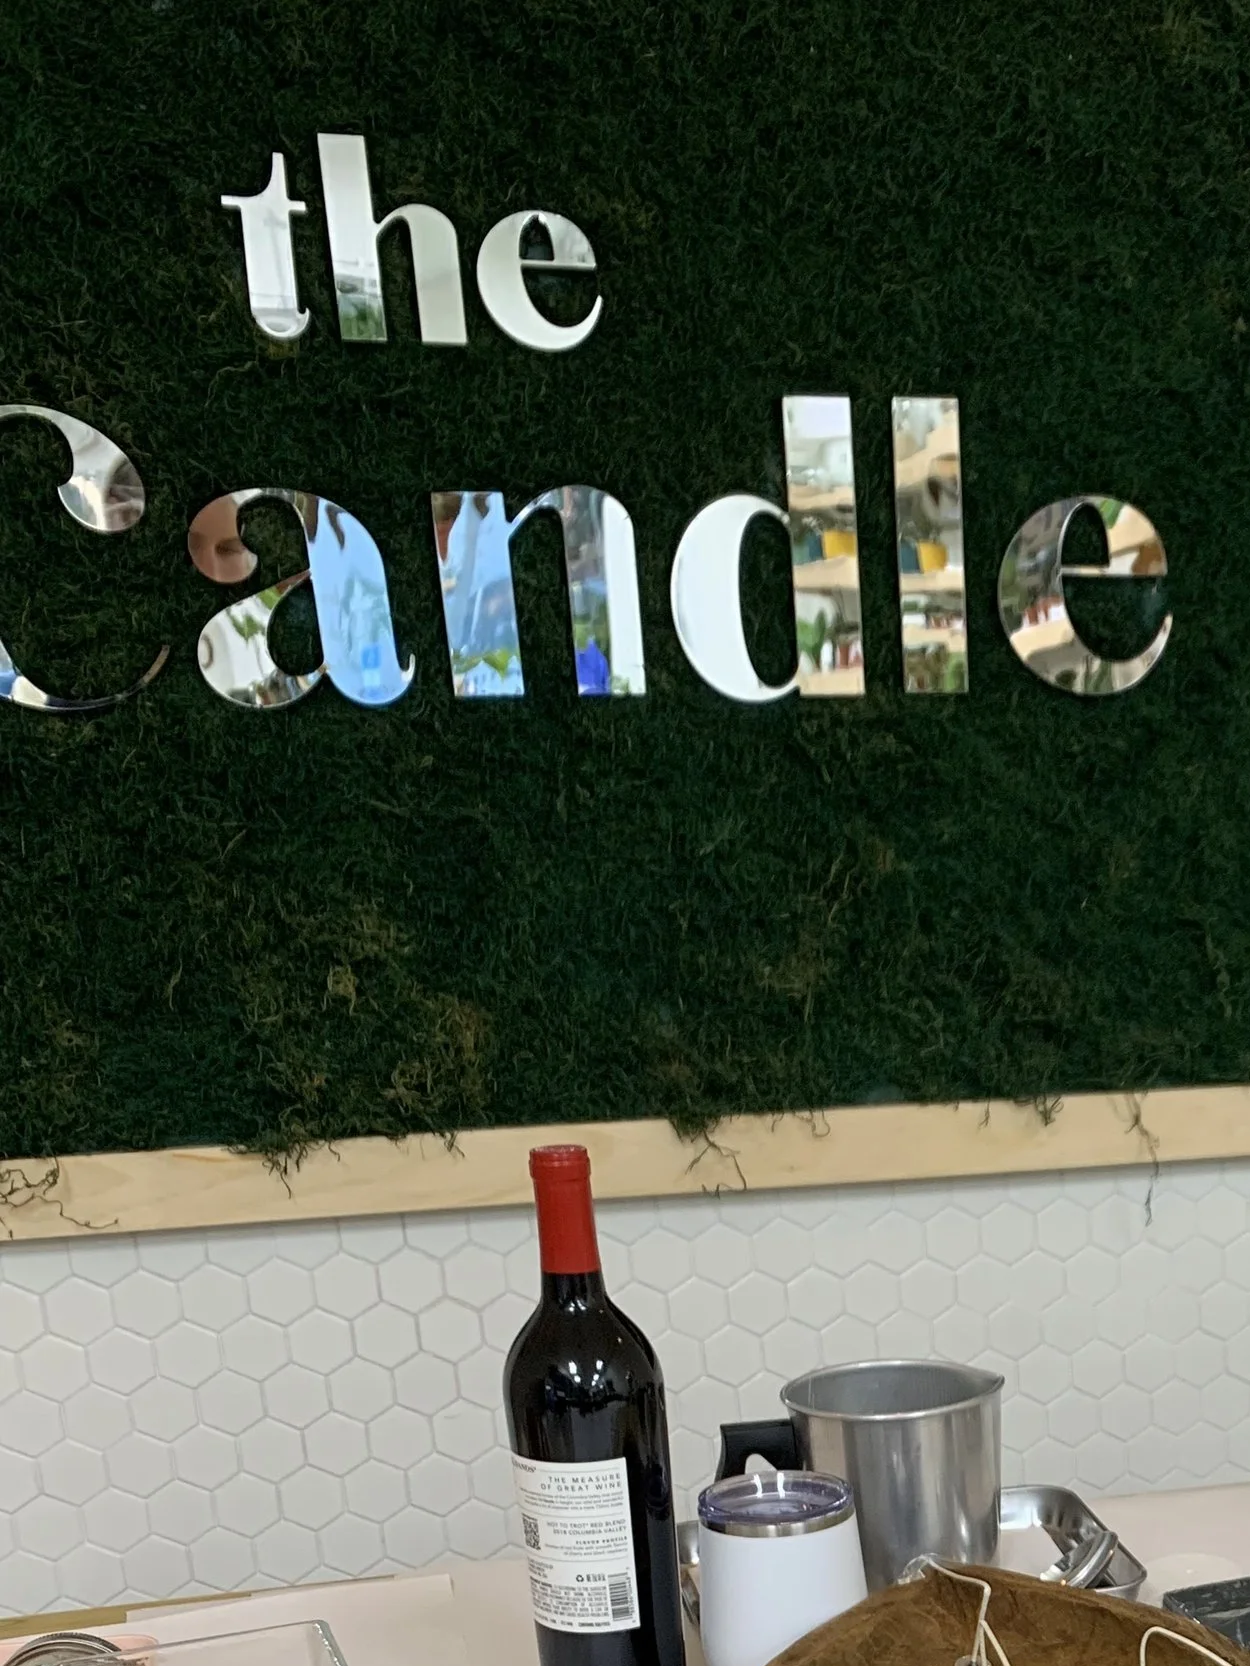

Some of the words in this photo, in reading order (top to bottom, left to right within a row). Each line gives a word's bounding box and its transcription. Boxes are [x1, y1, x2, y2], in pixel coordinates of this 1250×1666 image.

[221, 132, 604, 353] the
[0, 395, 1174, 712] Candle
[541, 1483, 551, 1491] OF
[557, 1484, 589, 1492] GREAT
[595, 1481, 621, 1491] WINE
[549, 1476, 566, 1484] THE
[572, 1473, 621, 1484] MEASURE
